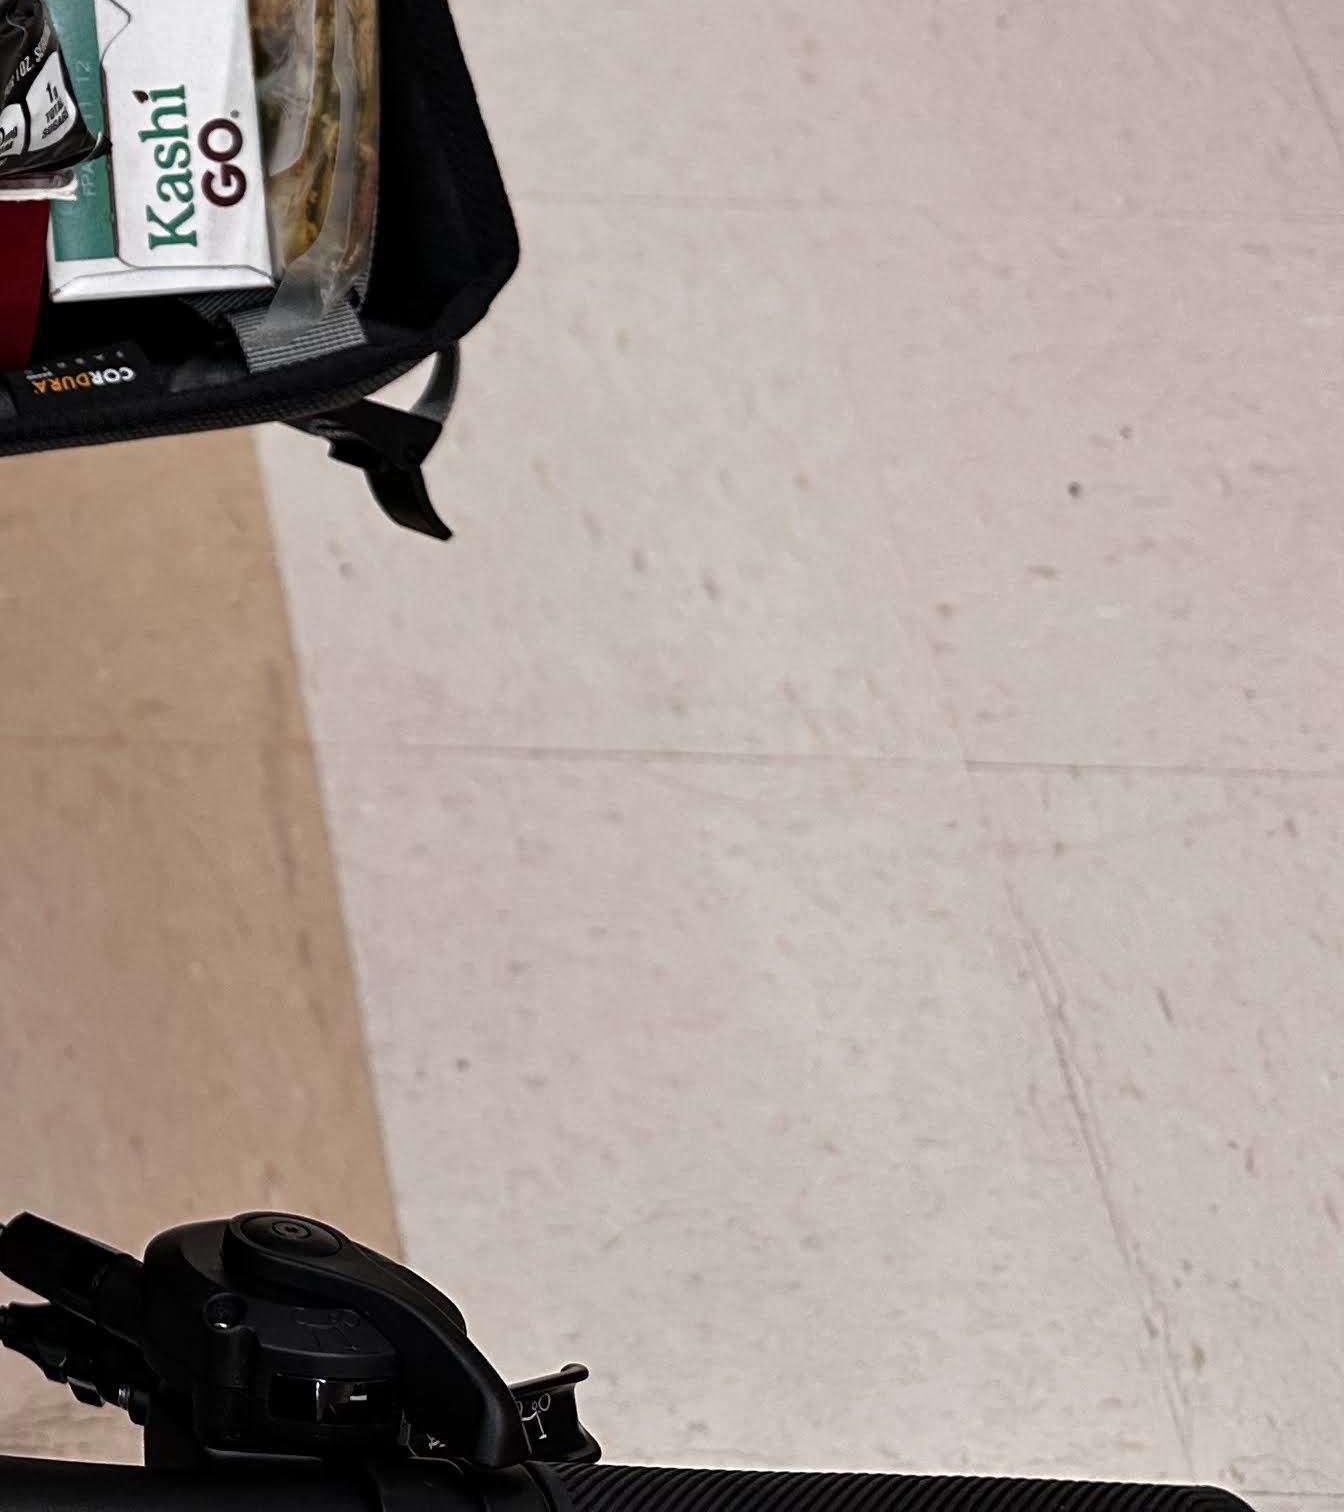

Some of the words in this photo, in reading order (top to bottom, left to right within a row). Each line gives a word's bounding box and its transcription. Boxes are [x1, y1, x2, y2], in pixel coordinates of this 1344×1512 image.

[135, 85, 198, 251] Kashi
[196, 117, 247, 208] GO
[33, 365, 135, 395] CORDURA
